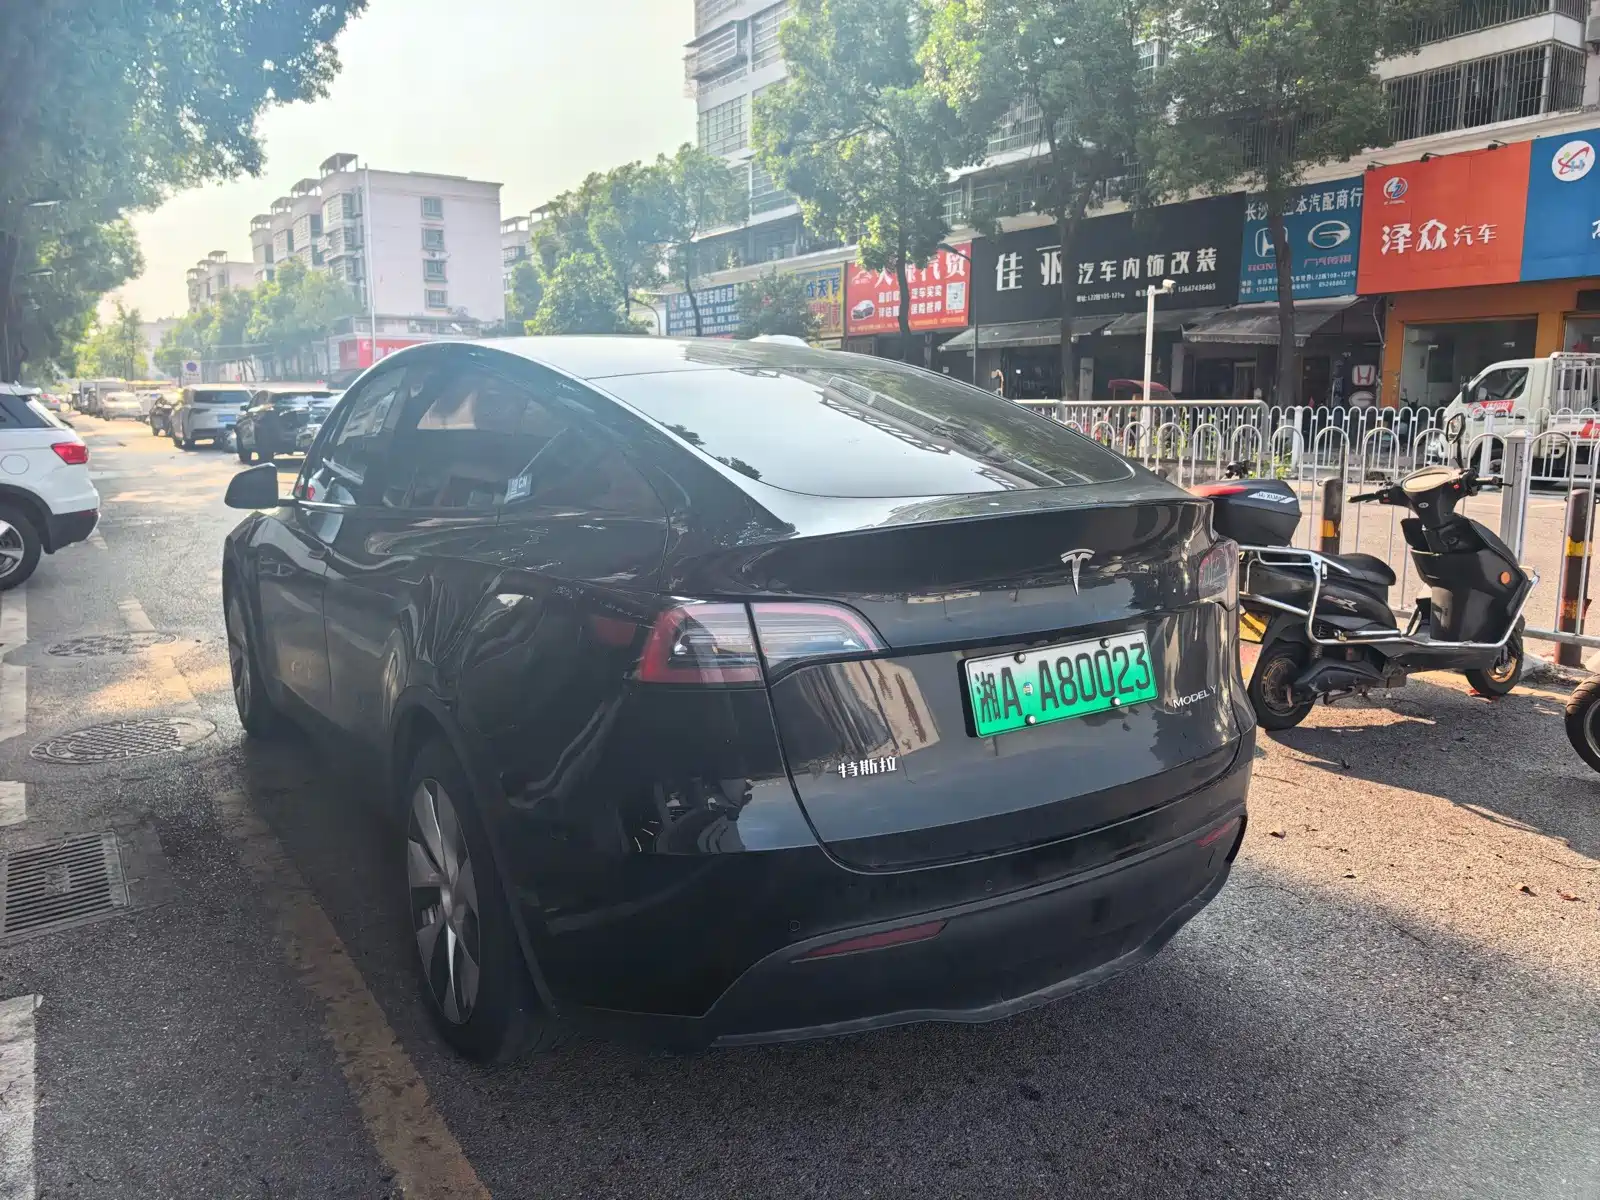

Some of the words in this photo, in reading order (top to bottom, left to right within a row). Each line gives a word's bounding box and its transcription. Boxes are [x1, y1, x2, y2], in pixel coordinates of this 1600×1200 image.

[1245, 187, 1364, 222] 长沙本汽配商行
[1381, 218, 1498, 256] 泽众汽车
[1077, 247, 1218, 285] 汽车内饰改装
[1247, 262, 1282, 272] HON
[974, 666, 1022, 723] 湘A
[1038, 642, 1149, 711] A80023
[1172, 690, 1210, 709] MODEL
[1209, 684, 1218, 696] Y
[838, 755, 897, 778] 特斯拉
